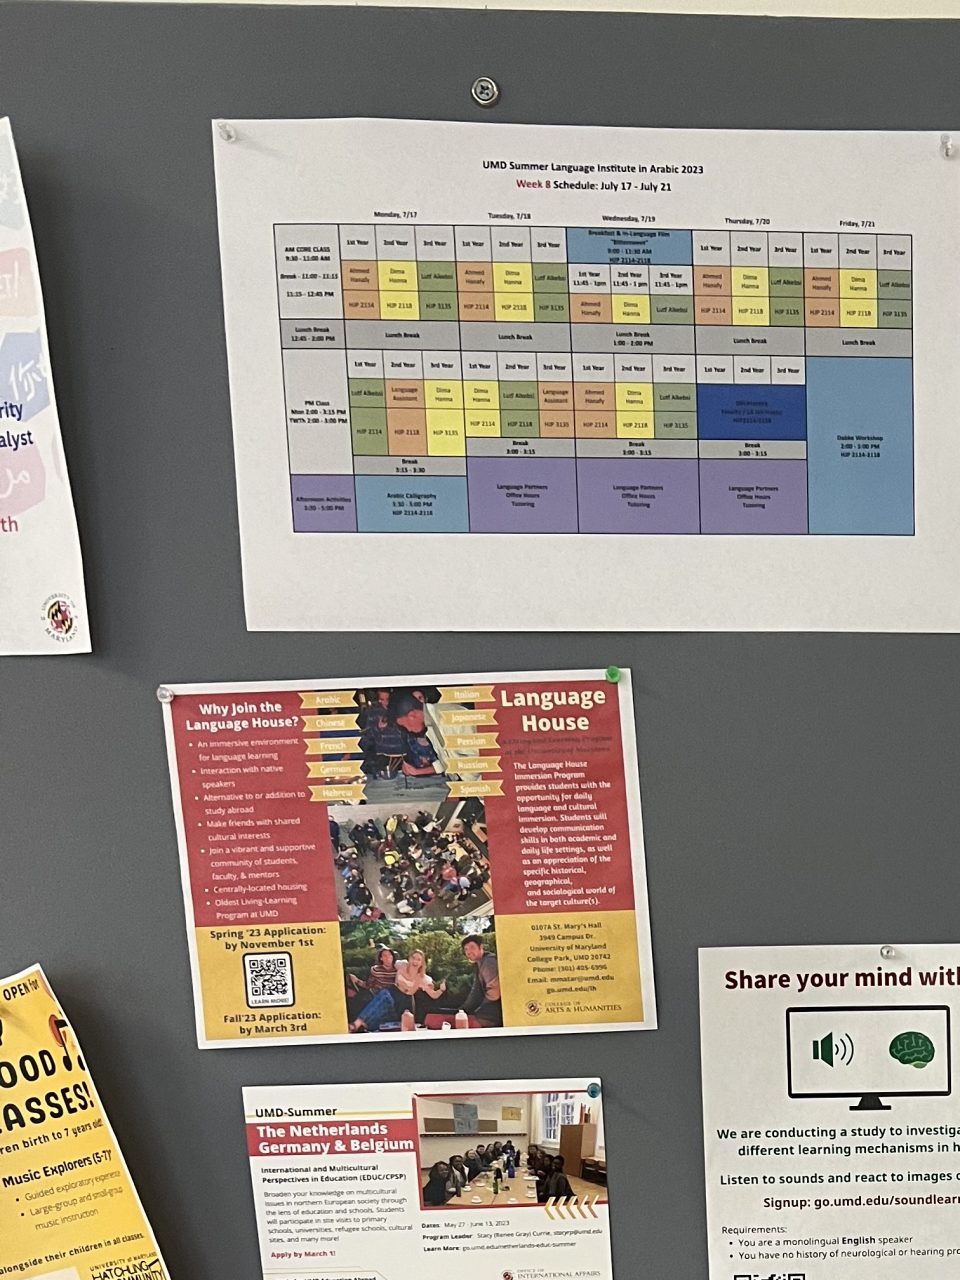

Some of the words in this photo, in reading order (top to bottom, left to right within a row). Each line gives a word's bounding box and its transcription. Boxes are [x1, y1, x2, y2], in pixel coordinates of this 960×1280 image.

[482, 160, 507, 169] UMD
[509, 160, 548, 171] Summer
[550, 162, 595, 174] Language
[597, 163, 636, 173] Institute
[638, 164, 647, 173] in
[649, 164, 679, 173] Arabic
[680, 164, 703, 174] 2023
[515, 179, 543, 188] Week
[545, 179, 551, 188] 8
[552, 179, 598, 190] Schedule:
[600, 180, 618, 192] July
[620, 181, 632, 190] 17
[639, 181, 658, 193] July
[660, 181, 671, 191] 21
[373, 210, 401, 219] Monday,
[402, 210, 417, 219] 7/17
[601, 215, 639, 223] Wednesday,
[640, 214, 655, 223] 7/19
[839, 219, 859, 227] Friday,
[860, 220, 875, 228] 7/21
[500, 689, 605, 710] Language
[198, 702, 229, 717] Why
[230, 701, 257, 716] Join
[259, 700, 282, 712] the
[185, 719, 249, 733] Language
[251, 715, 298, 728] House?
[521, 714, 589, 732] House
[209, 928, 244, 941] Spring
[263, 925, 326, 941] Application:
[224, 941, 237, 952] by
[240, 939, 295, 949] November
[297, 938, 314, 946] 1st
[724, 969, 790, 989] Share
[795, 971, 849, 993] your
[854, 965, 912, 987] mind
[3, 982, 30, 1001] OPEN
[258, 1010, 321, 1023] Application:
[239, 1025, 252, 1036] by
[254, 1023, 287, 1033] March
[289, 1022, 307, 1032] 3rd
[255, 1107, 337, 1118] UMD-Summer
[255, 1124, 285, 1138] The
[289, 1121, 387, 1137] Netherlands
[258, 1139, 331, 1155] Germany
[334, 1138, 347, 1151] &
[350, 1137, 414, 1153] Belgium
[2, 1169, 41, 1188] Music
[43, 1154, 93, 1177] Explorers
[328, 1164, 378, 1172] Multicultural
[720, 1174, 758, 1185] Listen
[761, 1174, 775, 1184] to
[778, 1172, 824, 1184] sounds
[827, 1171, 851, 1183] and
[854, 1172, 887, 1182] react
[890, 1172, 903, 1182] to
[907, 1170, 952, 1184] images
[763, 1196, 810, 1210] Signup:
[721, 1225, 787, 1235] Requirements:
